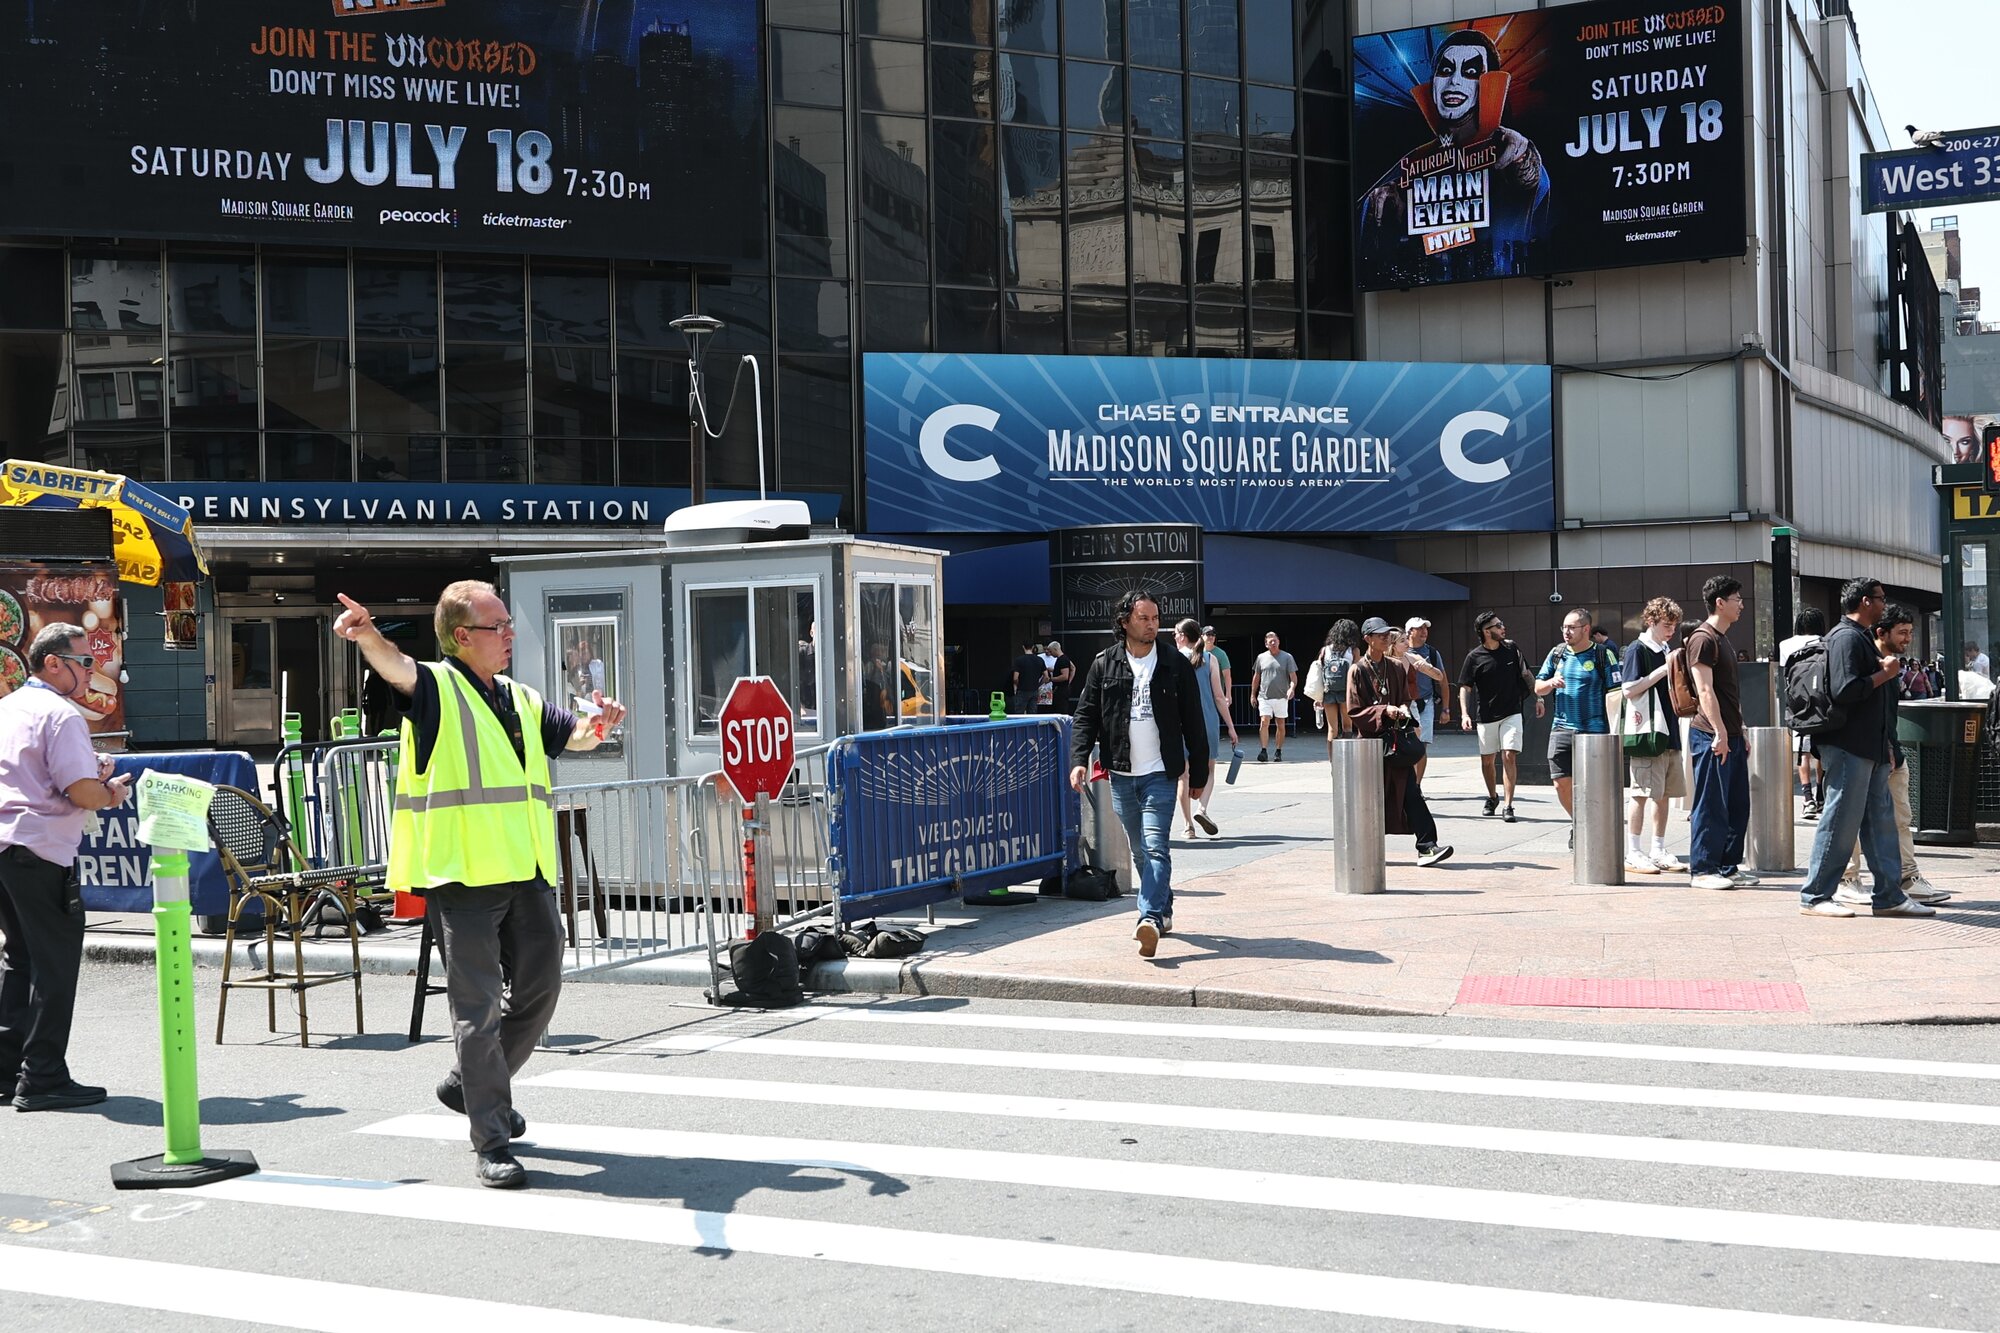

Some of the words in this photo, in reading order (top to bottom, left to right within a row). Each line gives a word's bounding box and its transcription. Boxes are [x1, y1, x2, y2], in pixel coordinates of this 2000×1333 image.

[1576, 24, 1608, 42] JOIN
[1613, 19, 1639, 36] THE
[1643, 5, 1725, 34] UNCURSED
[251, 26, 315, 58] JOIN
[324, 30, 377, 62] THE
[385, 32, 536, 76] UNCURSED
[1586, 44, 1619, 60] DON'T
[1622, 39, 1649, 55] MISS
[1653, 35, 1682, 50] WWE
[1686, 30, 1716, 46] LIVE!
[269, 69, 336, 96] DON'T
[344, 74, 396, 99] MISS
[403, 77, 458, 104] WWE
[466, 81, 520, 108] LIVE!
[1591, 64, 1708, 100] SATURDAY
[1565, 105, 1668, 158] JULY
[1680, 99, 1724, 144] 18
[130, 145, 292, 181] SATURDAY
[303, 118, 467, 189] JULY
[487, 128, 553, 194] 18
[1945, 139, 1971, 152] 200
[1413, 170, 1482, 203] MAIN
[1612, 161, 1690, 188] 7:30PM
[1881, 161, 1964, 195] West
[221, 198, 268, 214] MADISON
[271, 200, 310, 217] SQUARE
[314, 202, 353, 219] GARDEN
[380, 208, 451, 224] peacock
[482, 212, 567, 229] ticketmaster
[1414, 197, 1483, 227] EVENT
[1602, 209, 1638, 222] MADISON
[1640, 204, 1670, 218] SQUARE
[1672, 201, 1704, 215] GARDEN
[1427, 226, 1471, 251] NYC
[1625, 229, 1678, 242] ticketmaster
[1098, 404, 1176, 421] CHASE
[1211, 406, 1349, 424] ENTRANCE
[919, 404, 1001, 481] C
[1048, 430, 1171, 472] MADISON
[1182, 430, 1282, 476] SQUARE
[1292, 431, 1391, 473] GARDEN
[1440, 410, 1511, 483] C
[1102, 478, 1128, 486] THE
[1134, 478, 1194, 486] WORLD'S
[1200, 478, 1236, 487] MOST
[1242, 479, 1294, 487] FAMOUS
[1300, 479, 1341, 487] ARENA
[178, 496, 481, 520] PENNSYLVANIA
[502, 499, 649, 521] STATION
[1123, 531, 1188, 554] STATION
[1161, 595, 1195, 615] GARDEN
[727, 716, 789, 766] STOP
[156, 780, 202, 799] PARKING
[919, 814, 993, 846] WELCOME
[998, 811, 1013, 832] TO
[79, 855, 152, 887] REN
[892, 851, 938, 887] THE
[944, 833, 1040, 878] GARDEN
